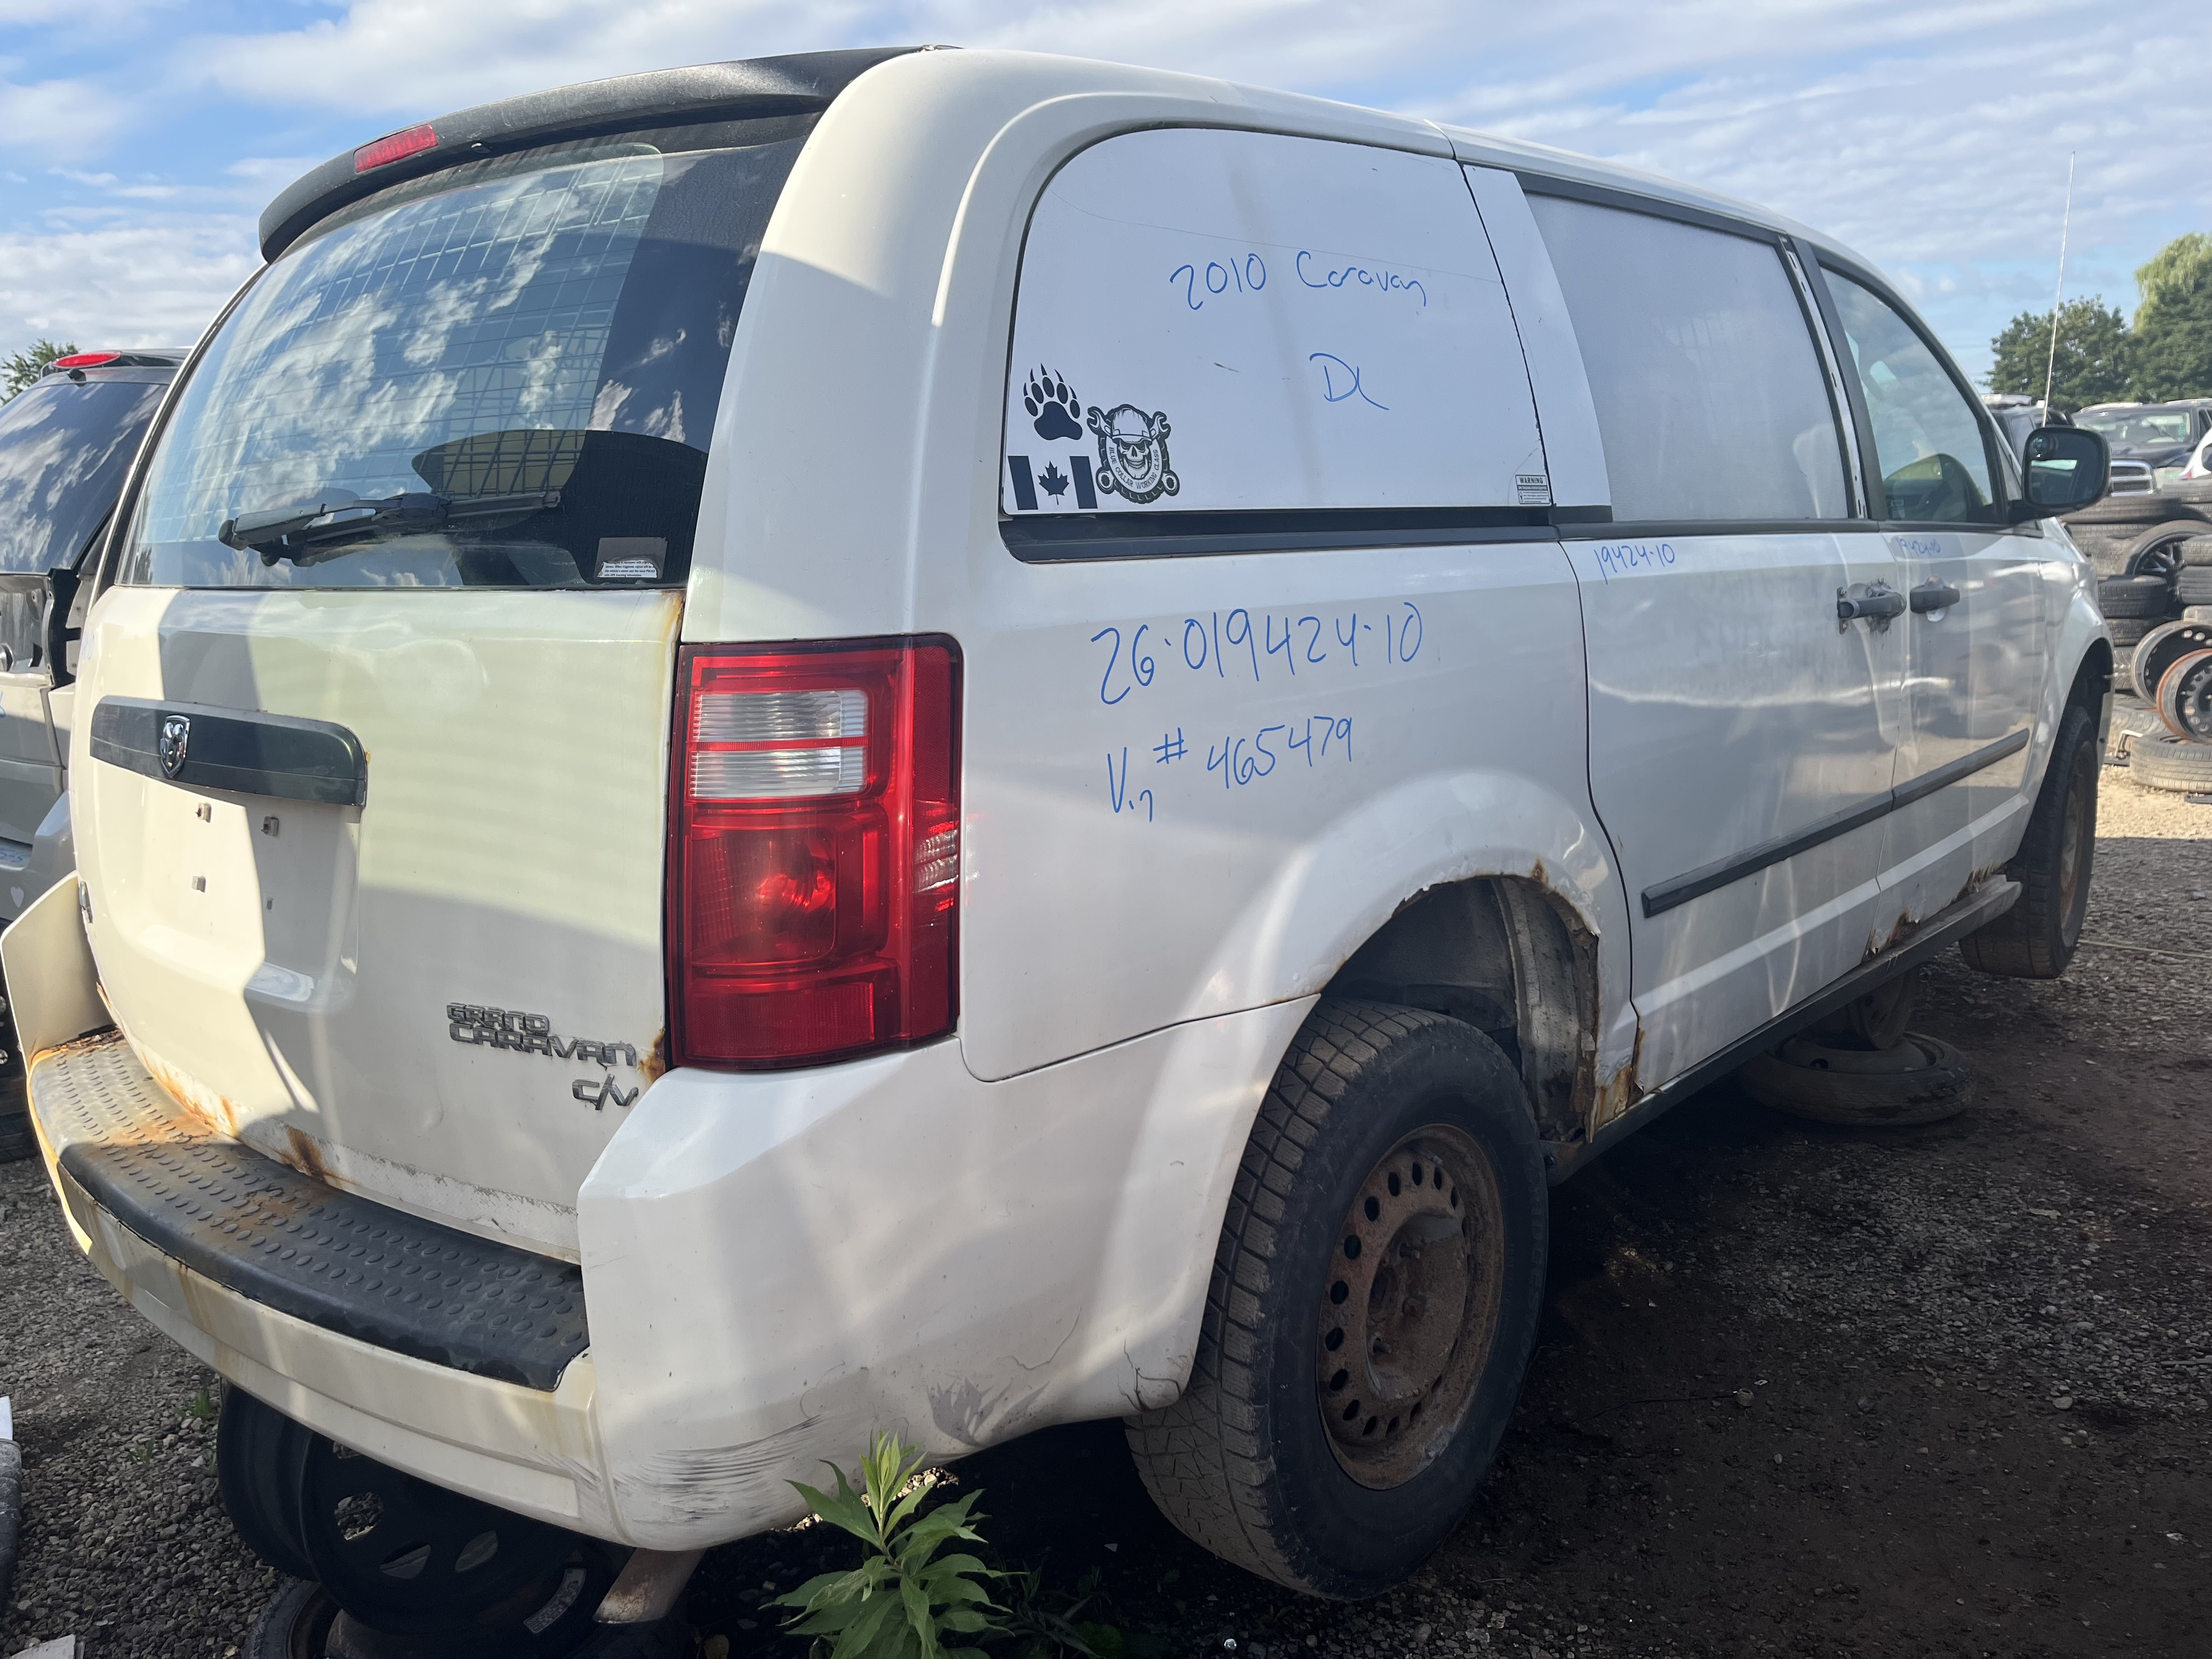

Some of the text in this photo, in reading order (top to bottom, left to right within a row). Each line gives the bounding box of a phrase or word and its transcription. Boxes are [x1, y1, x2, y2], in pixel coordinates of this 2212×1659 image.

[1169, 253, 1266, 311] 2010
[1109, 446, 1117, 465] BLUE
[1115, 466, 1134, 488] COLLAR
[1135, 472, 1157, 490] WORKING
[1152, 727, 1188, 764] #
[1207, 715, 1352, 789] 465479
[446, 1002, 549, 1035] GRAND
[449, 1023, 637, 1066] CARAVAN
